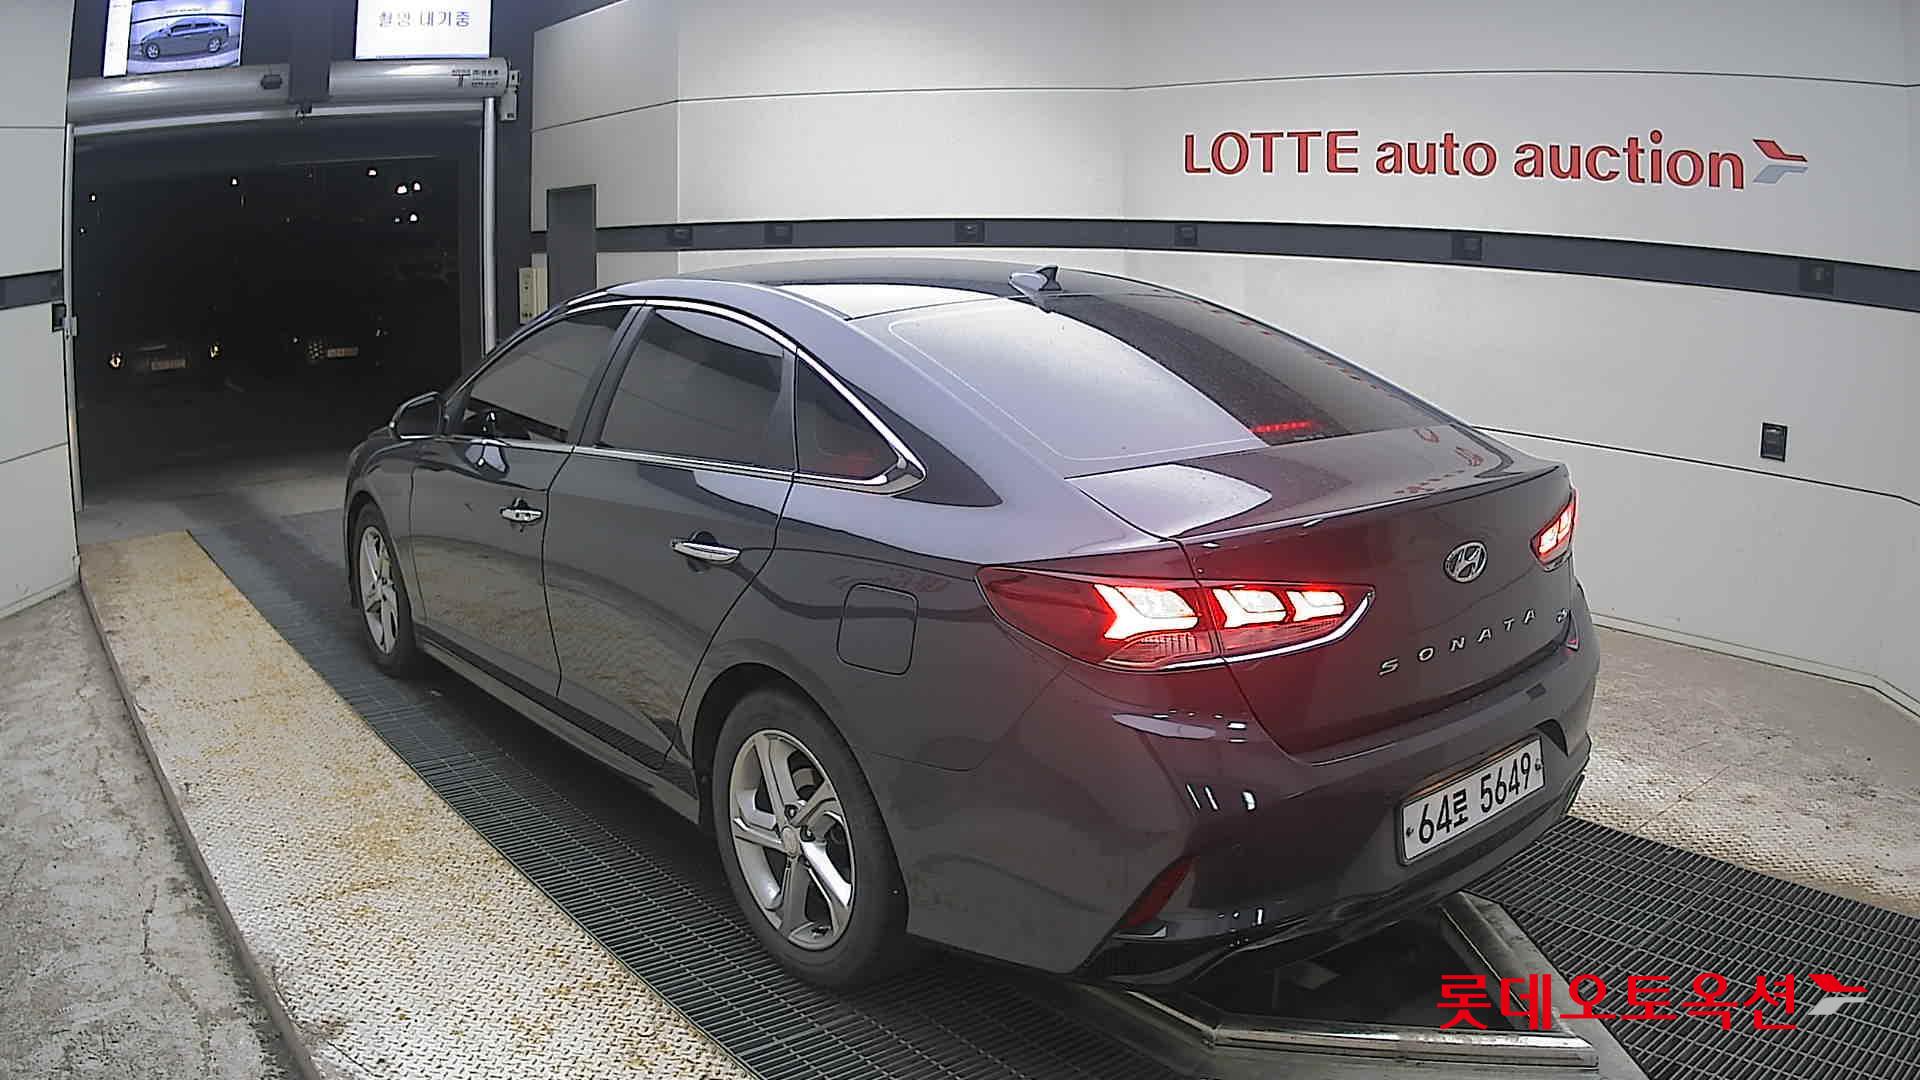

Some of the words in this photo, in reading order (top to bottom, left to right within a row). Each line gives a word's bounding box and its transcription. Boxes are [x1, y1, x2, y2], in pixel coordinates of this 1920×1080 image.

[1184, 129, 1360, 175] LOTTE
[1376, 132, 1497, 177] auto
[1513, 129, 1746, 190] auction
[1378, 608, 1537, 677] SONATA
[1418, 788, 1469, 844] 64로
[1479, 752, 1531, 813] 5649
